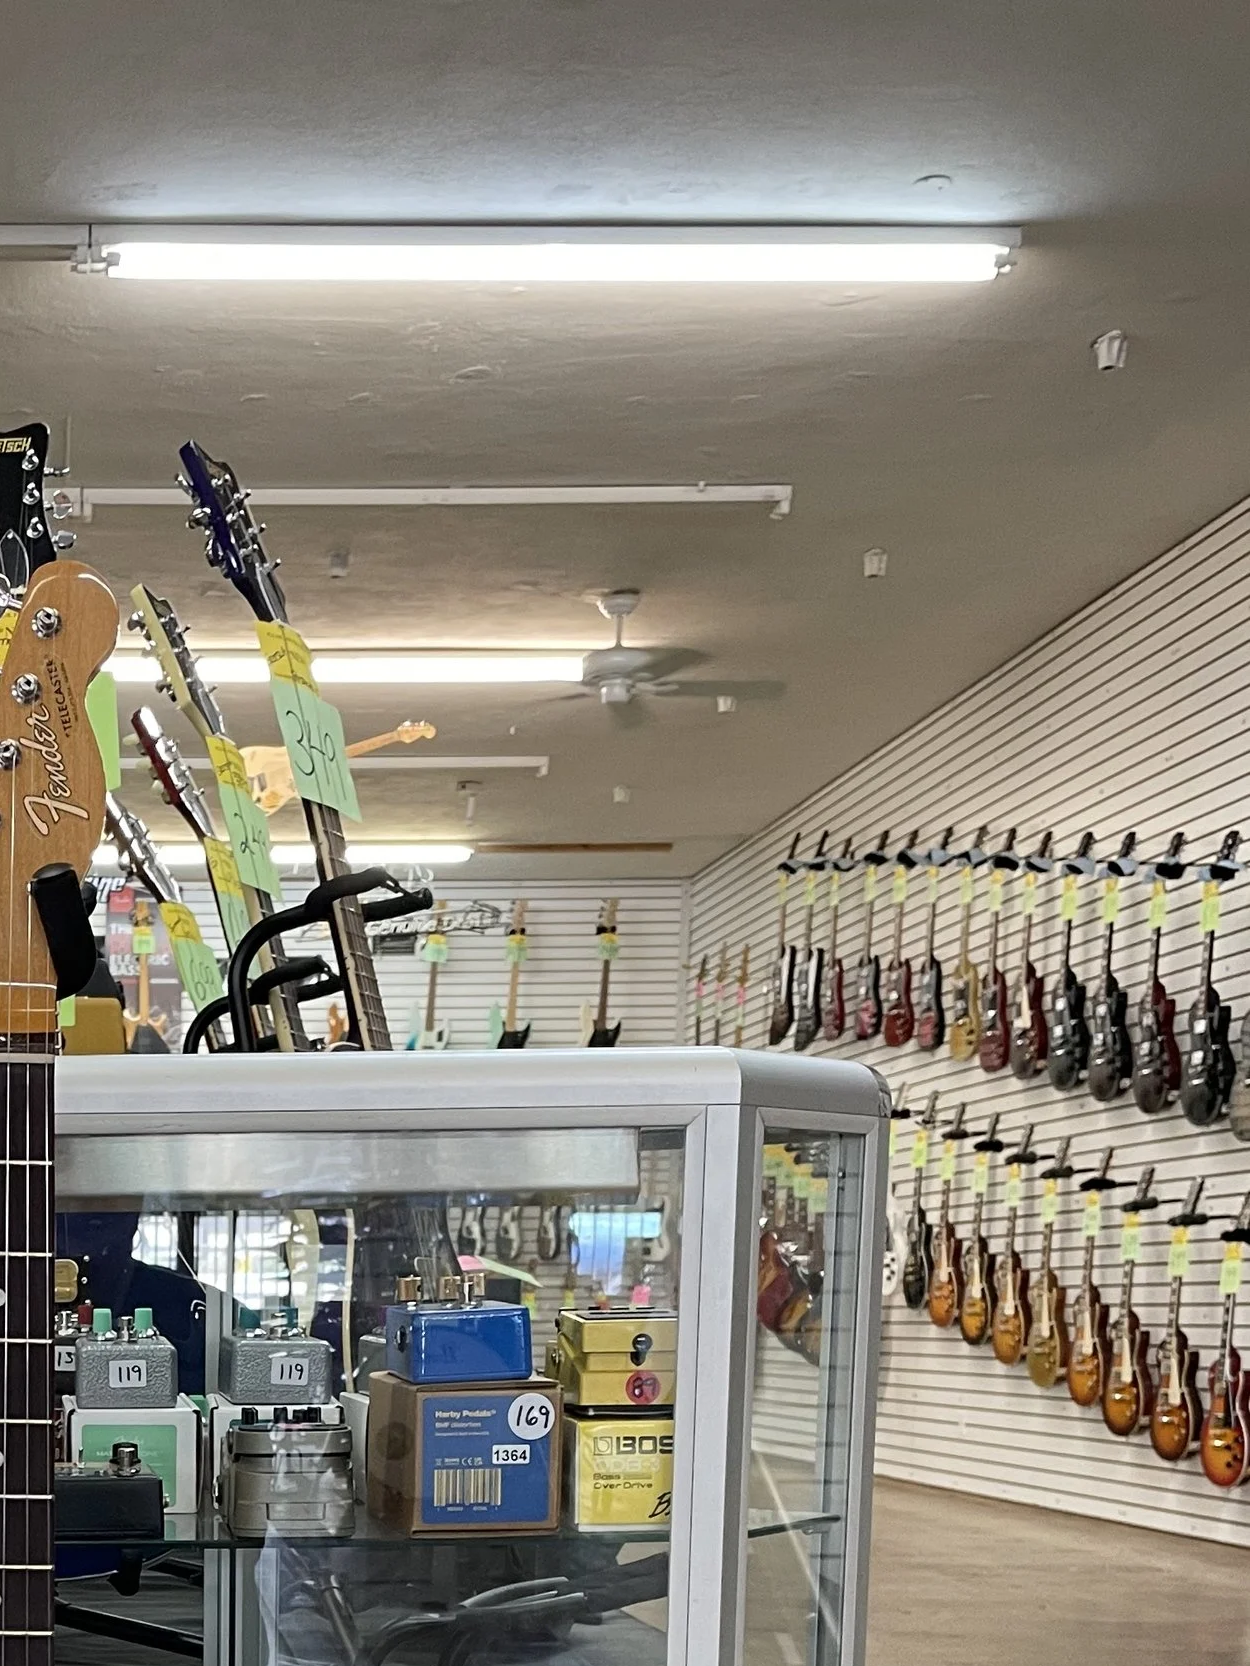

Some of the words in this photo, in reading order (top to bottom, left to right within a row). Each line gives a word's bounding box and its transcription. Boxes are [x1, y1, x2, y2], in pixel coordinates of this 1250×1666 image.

[285, 709, 349, 802] 349
[18, 701, 91, 837] Fender
[117, 1364, 143, 1383] 119
[279, 1363, 305, 1381] 119
[515, 1404, 551, 1429] 169
[493, 1449, 528, 1462] 1364
